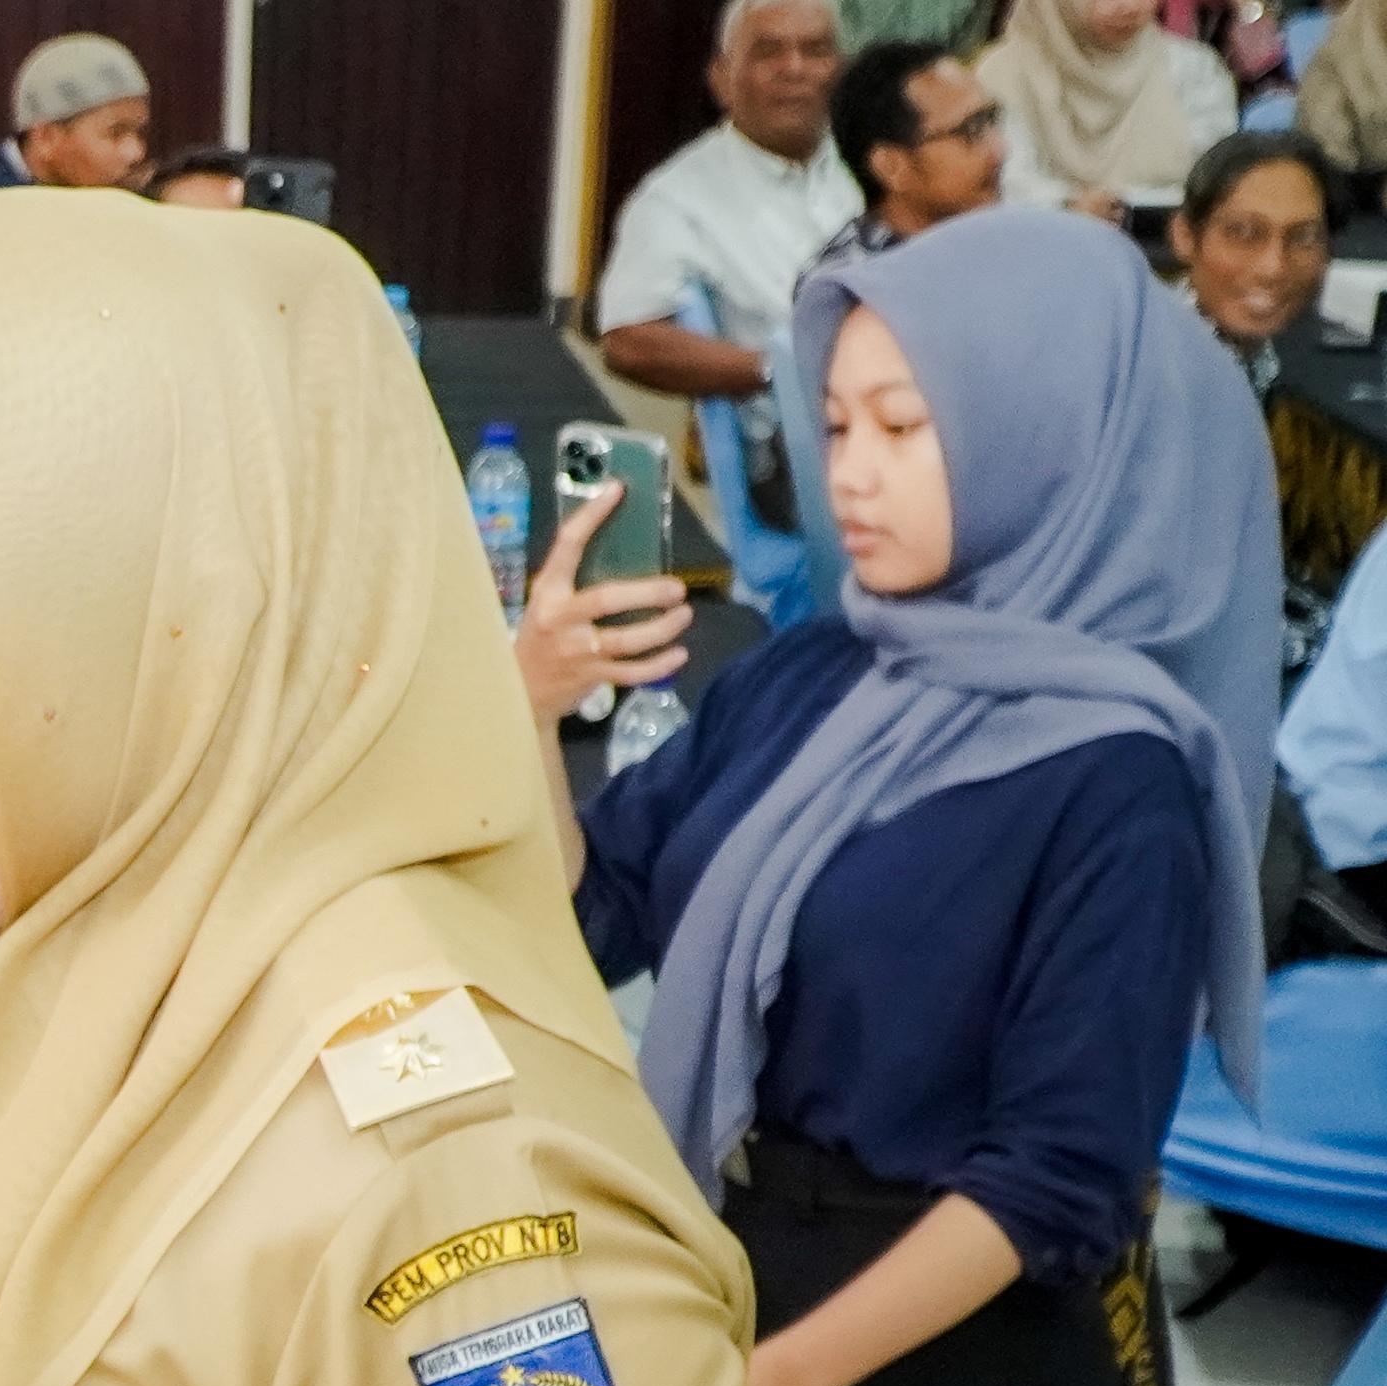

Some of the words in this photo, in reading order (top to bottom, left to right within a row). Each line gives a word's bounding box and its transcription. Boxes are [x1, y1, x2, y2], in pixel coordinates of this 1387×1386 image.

[373, 1264, 435, 1321] PEM
[435, 1227, 506, 1277] PROV
[519, 1218, 572, 1254] NTB
